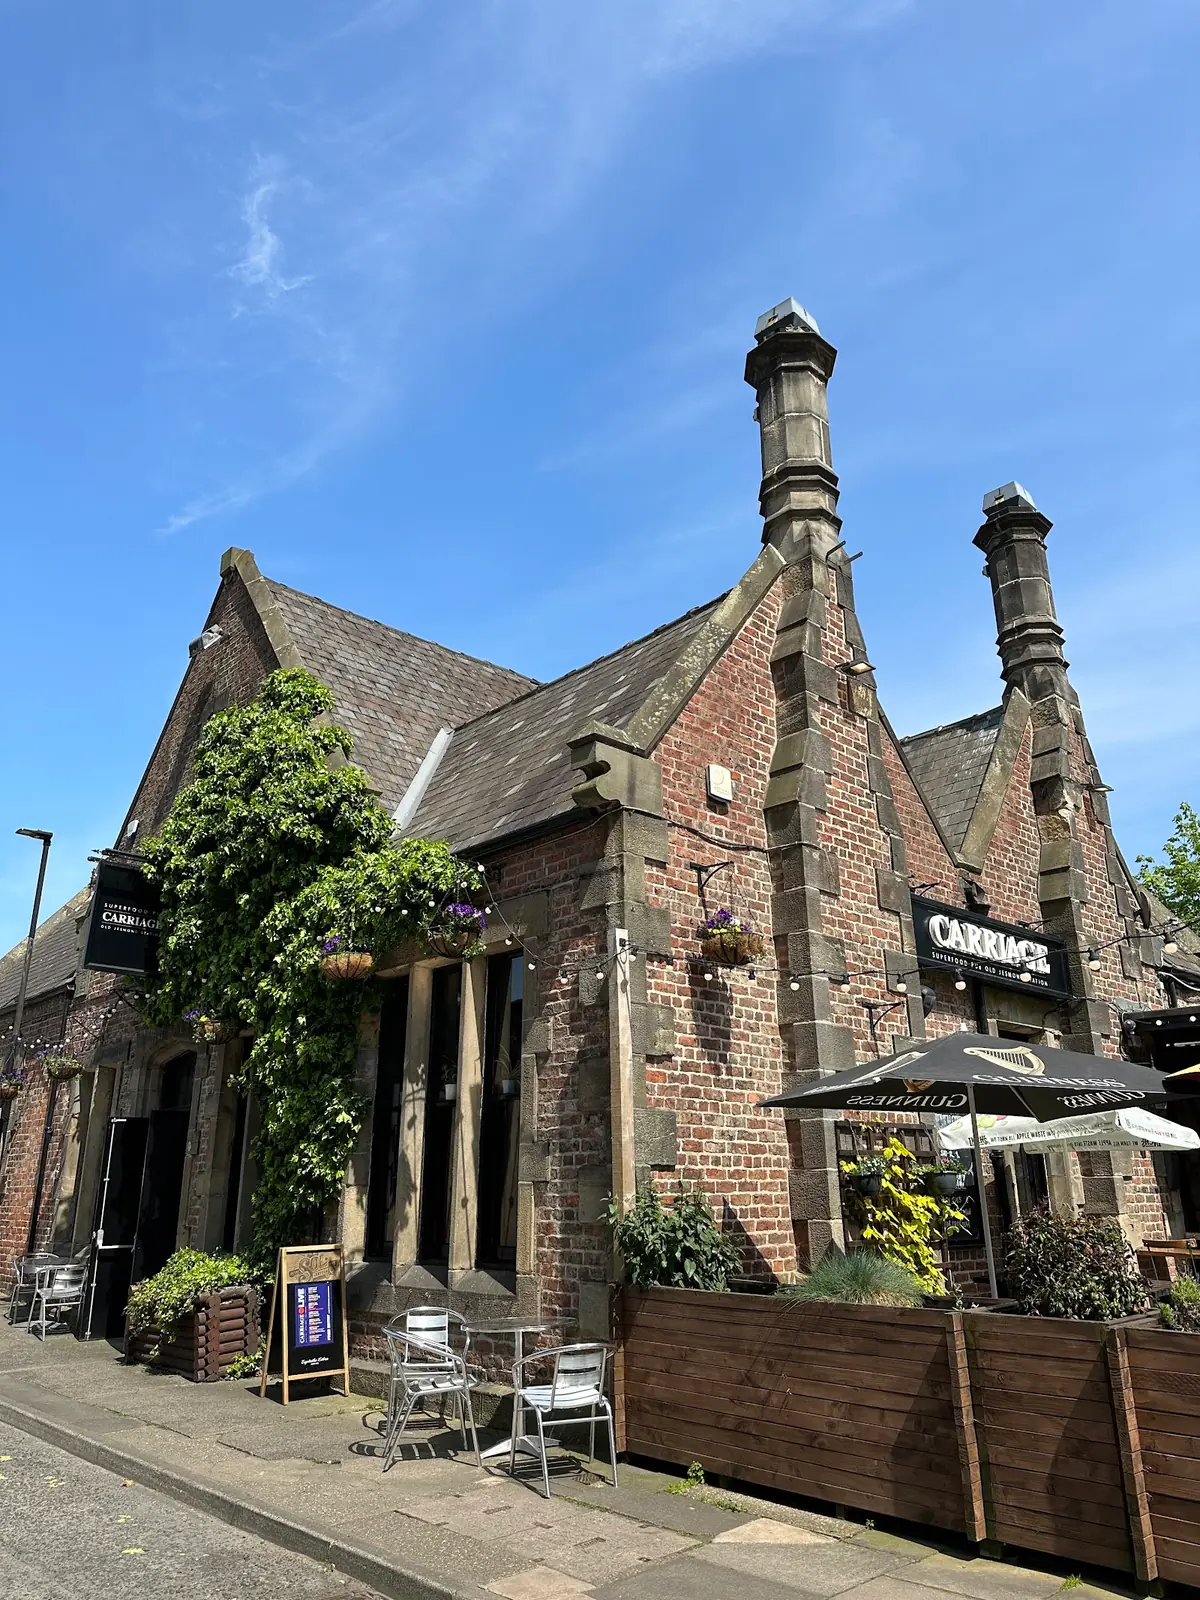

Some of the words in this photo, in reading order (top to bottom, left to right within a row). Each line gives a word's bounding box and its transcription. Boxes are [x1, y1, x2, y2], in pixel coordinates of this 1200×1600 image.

[104, 902, 148, 914] SUPERFOOD
[928, 914, 1051, 975] CARRIAGE
[931, 951, 968, 967] SUPERFOOD
[984, 965, 997, 975] OLD
[998, 968, 1021, 980] JESMON
[972, 1073, 1127, 1089] GUINNESS
[1016, 1131, 1030, 1140] APPLE
[1030, 1130, 1046, 1138] WASTE
[297, 1288, 305, 1308] LIVE
